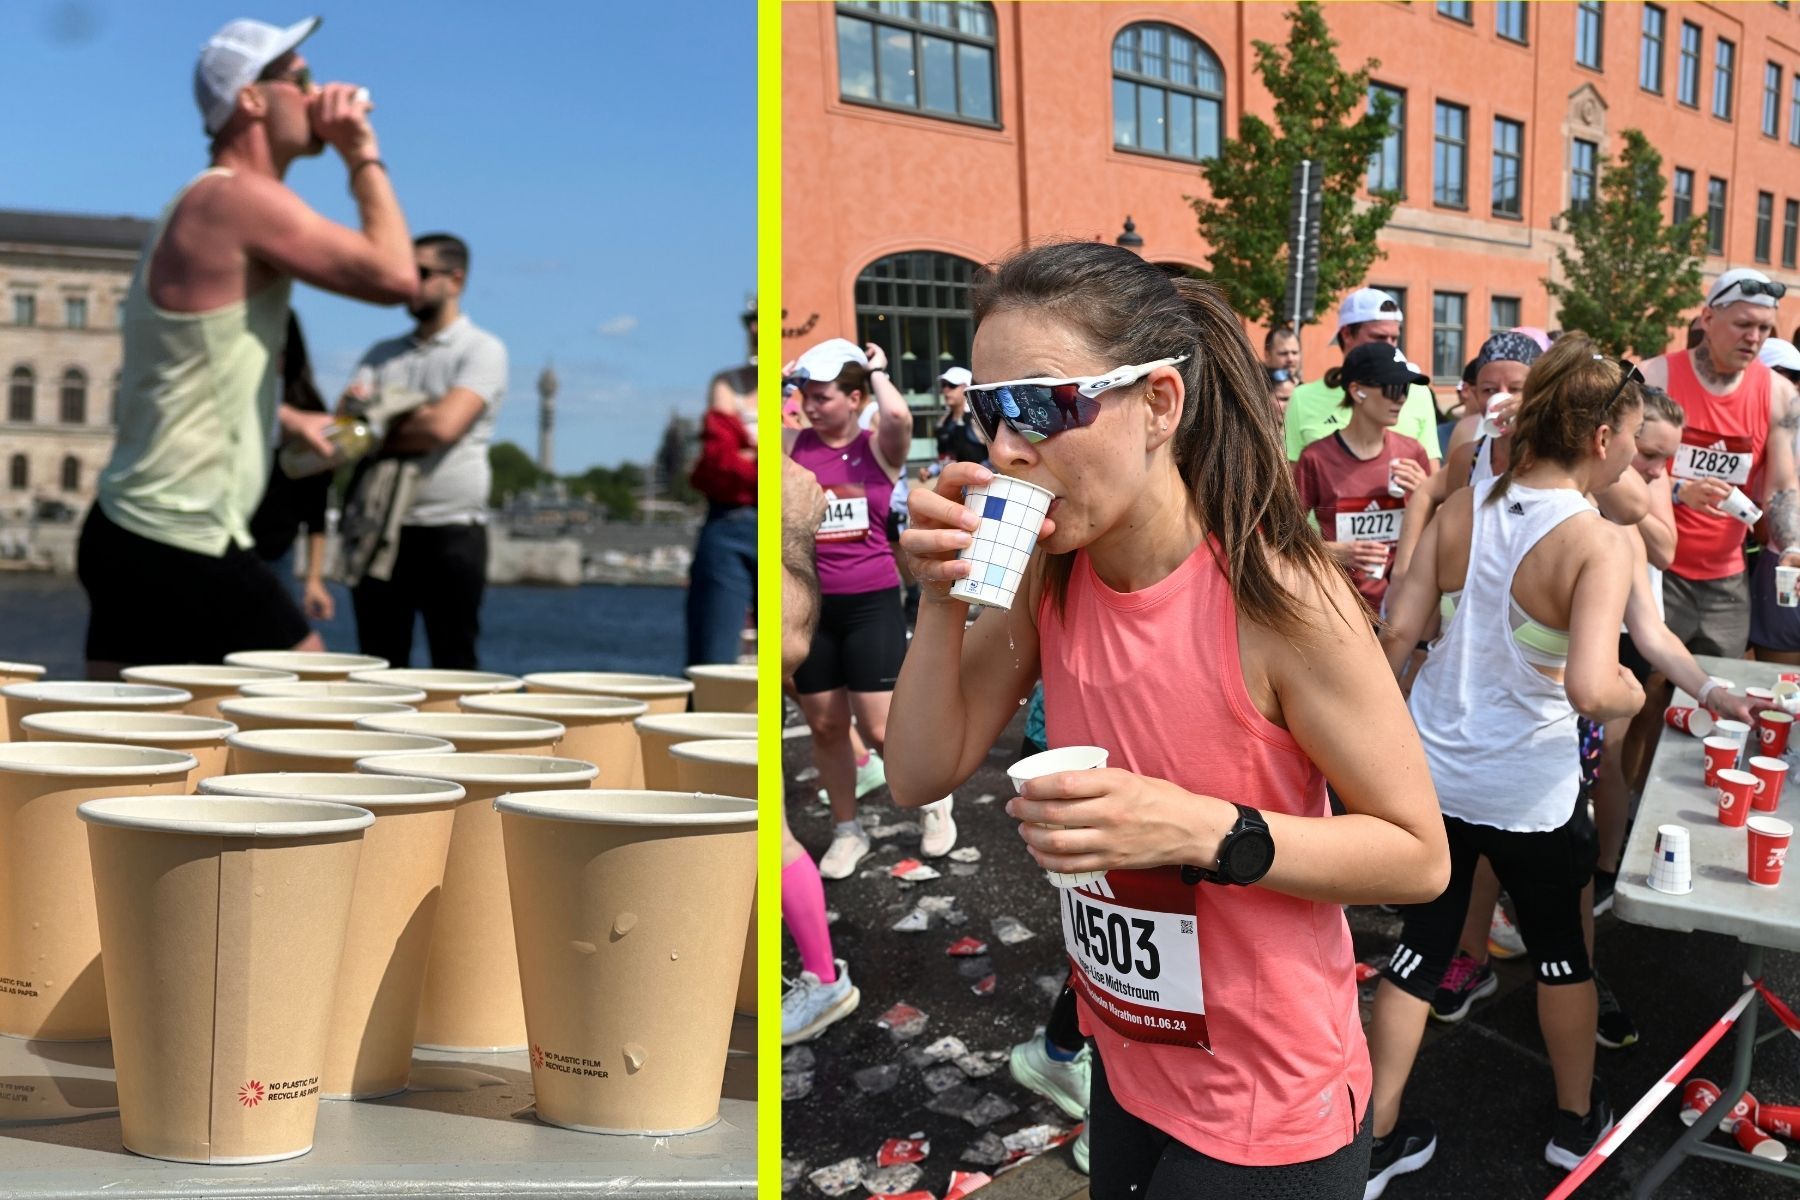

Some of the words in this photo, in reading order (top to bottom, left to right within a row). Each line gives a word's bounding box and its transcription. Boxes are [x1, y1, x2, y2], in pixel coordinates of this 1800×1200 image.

[1689, 448, 1740, 475] 12829
[821, 502, 854, 523] 144
[1350, 513, 1394, 535] 12272
[1067, 889, 1161, 980] 14503
[16, 980, 31, 988] FILM
[1105, 973, 1160, 1002] Midtstraum
[1108, 1001, 1142, 1025] Marathon
[1144, 1015, 1187, 1031] 01.06.24
[544, 1051, 553, 1060] NO
[554, 1053, 580, 1065] PLASTIC
[582, 1059, 601, 1067] FILM
[545, 1061, 571, 1073] RECYCLE
[572, 1067, 582, 1075] AS
[583, 1069, 609, 1079] PAPER
[268, 1091, 298, 1101] RECYCLE
[299, 1089, 307, 1098] AS
[269, 1082, 281, 1091] NO
[282, 1079, 308, 1089] PLASTIC
